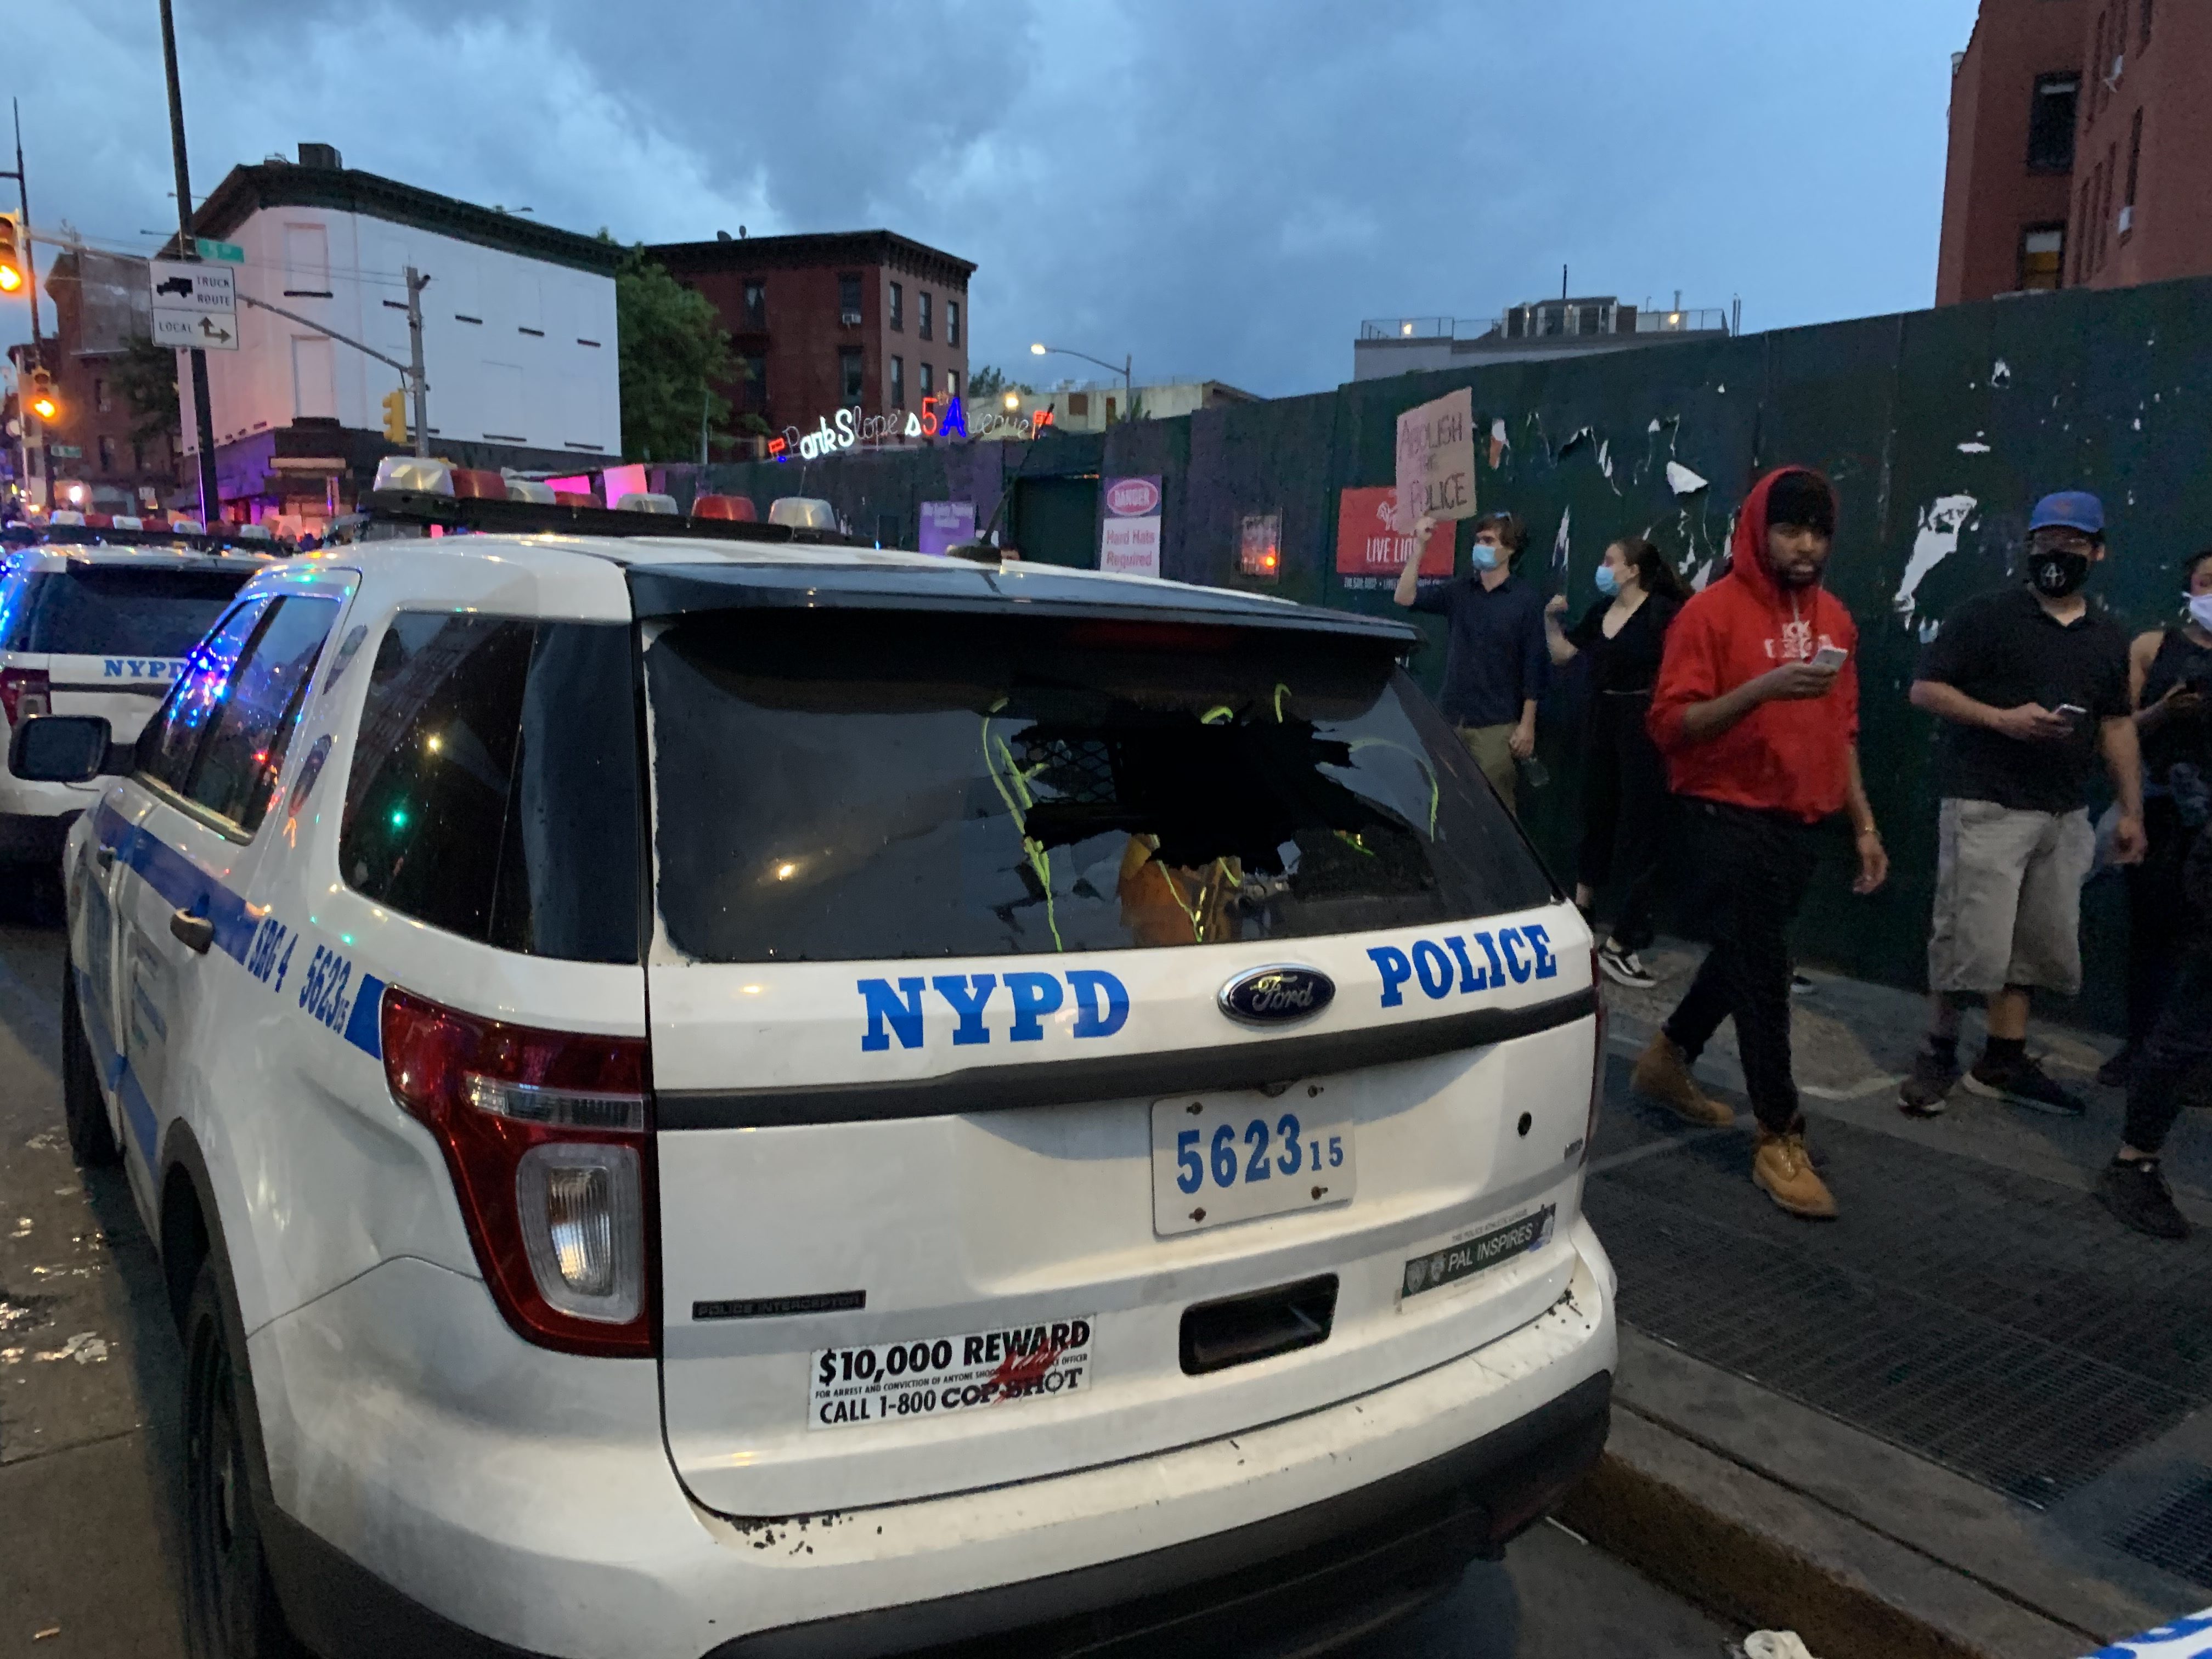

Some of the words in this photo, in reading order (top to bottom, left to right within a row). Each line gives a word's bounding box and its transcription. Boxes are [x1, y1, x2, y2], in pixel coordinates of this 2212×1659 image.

[197, 275, 230, 287] TRUCK
[197, 294, 230, 306] ROUTE
[159, 321, 191, 333] LOCAL
[782, 416, 836, 460] Park
[940, 397, 1029, 438] Avenue
[1107, 529, 1129, 545] Hard
[1133, 528, 1155, 545] Hats
[1366, 537, 1391, 562] LIVE
[1107, 550, 1152, 569] Required
[274, 933, 298, 993] 4
[1367, 924, 1558, 1008] POLICE
[1250, 972, 1314, 1012] Ford
[857, 970, 1130, 1052] NYPD
[1177, 1113, 1302, 1194] 5623
[1447, 1247, 1473, 1272] PAL
[1477, 1222, 1533, 1261] INSPIRES
[698, 1304, 753, 1316] POLICE
[819, 1340, 952, 1387] $10,000
[964, 1321, 1090, 1366] REWARD
[1062, 1353, 1087, 1365] OFFICER
[815, 1390, 831, 1399] FOR
[834, 1386, 862, 1397] ARREST
[865, 1384, 881, 1393] AND
[883, 1377, 929, 1392] CONVICTION
[932, 1376, 941, 1385] OF
[943, 1372, 973, 1384] ANYONE
[820, 1398, 870, 1424] CALL
[880, 1390, 936, 1418] 1-800
